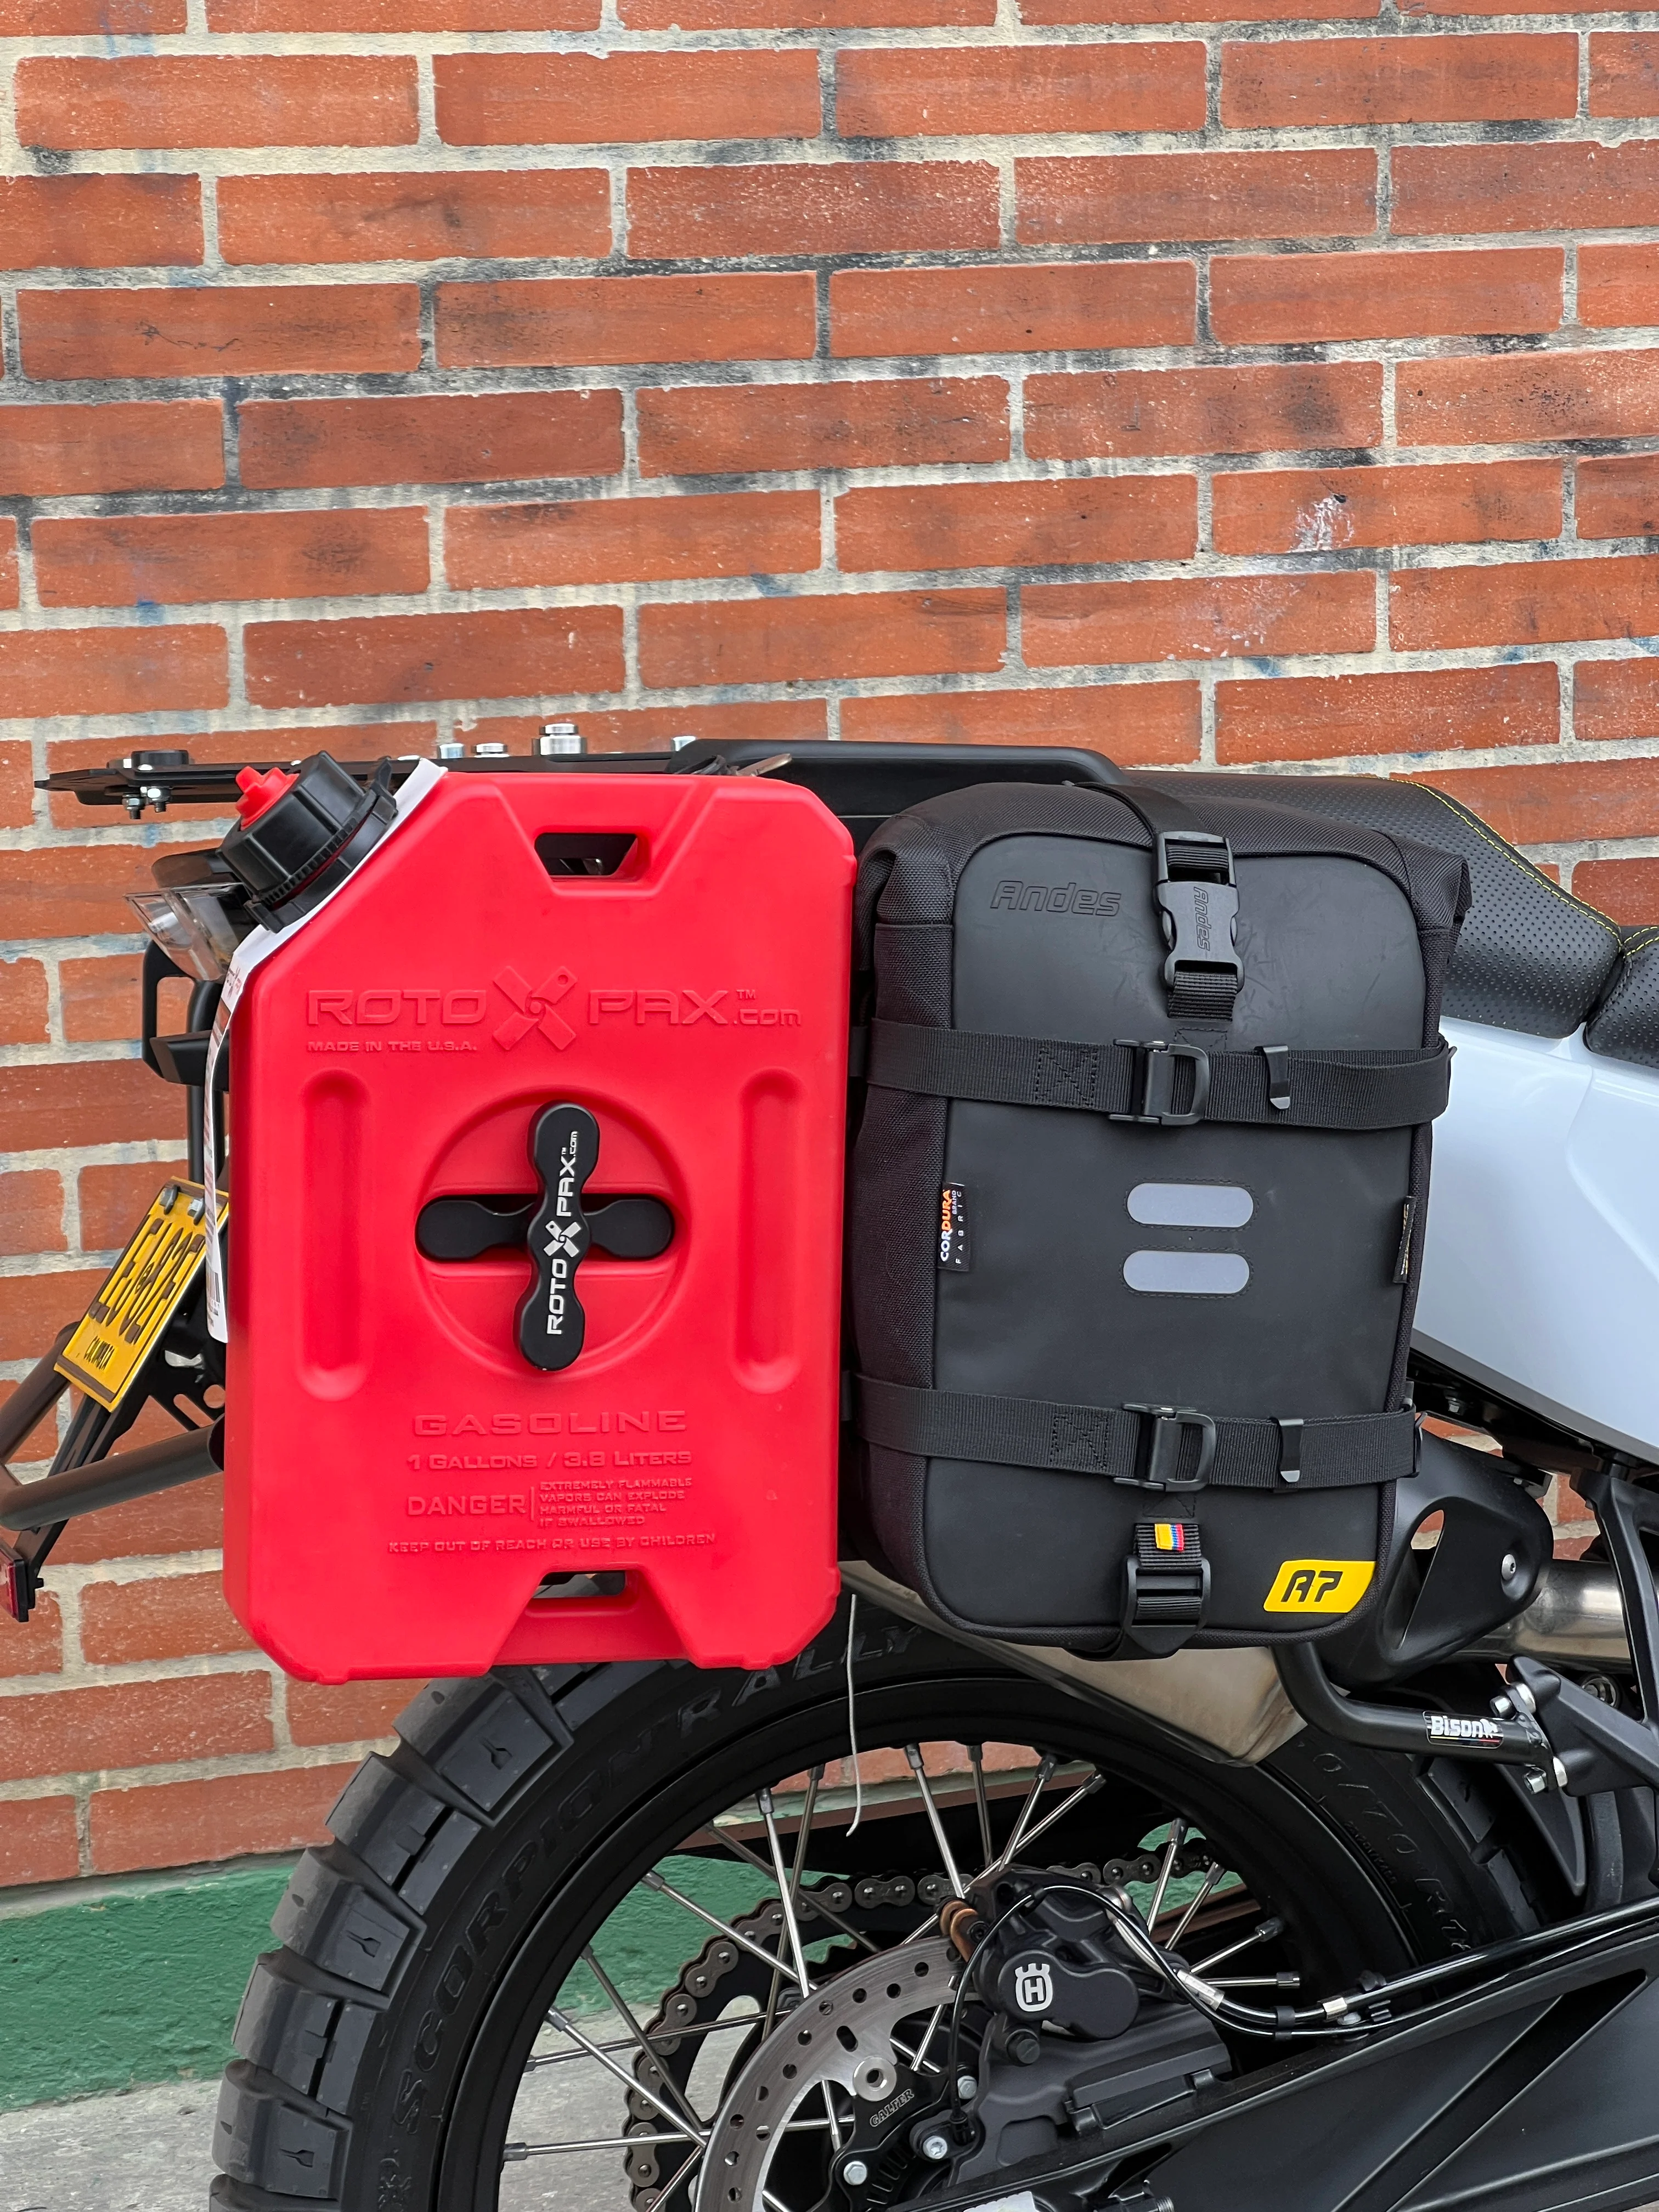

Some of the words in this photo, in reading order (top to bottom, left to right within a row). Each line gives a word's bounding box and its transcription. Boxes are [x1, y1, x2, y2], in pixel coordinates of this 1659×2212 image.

[991, 880, 1122, 917] Andes
[1193, 886, 1212, 951] Andes
[307, 989, 487, 1025] ROTO
[307, 1041, 359, 1052] MADE
[365, 1041, 382, 1052] IN
[387, 1041, 422, 1052] THE
[427, 1041, 478, 1051] U.S.A.
[940, 1189, 953, 1262] CORDURA
[546, 1258, 567, 1335] ROTO
[414, 1410, 687, 1436] GASOLINE
[407, 1454, 421, 1470] 1
[428, 1454, 538, 1469] GALLONS
[563, 1451, 605, 1467] 3.8
[614, 1451, 692, 1466] LITERS
[539, 1481, 614, 1491] EXTREMELY
[618, 1477, 692, 1488] FLAMMABLE
[407, 1495, 527, 1516] DANGER
[539, 1493, 592, 1502] VAPORS
[596, 1492, 622, 1502] CAN
[628, 1490, 685, 1500] EXPLODE
[539, 1505, 600, 1515] HARMFUL
[605, 1504, 622, 1513] OR
[627, 1503, 667, 1513] FATAL
[539, 1517, 554, 1527] IF
[557, 1515, 646, 1527] SWALLOWED
[389, 1542, 429, 1553] KEEP
[434, 1541, 466, 1551] OUT
[470, 1540, 491, 1551] OF
[495, 1539, 547, 1551] REACH
[552, 1538, 575, 1549] OR
[579, 1537, 611, 1548] USE
[616, 1536, 636, 1548] BY
[640, 1533, 715, 1547] CHILDREN
[869, 2088, 915, 2128] GALFER
